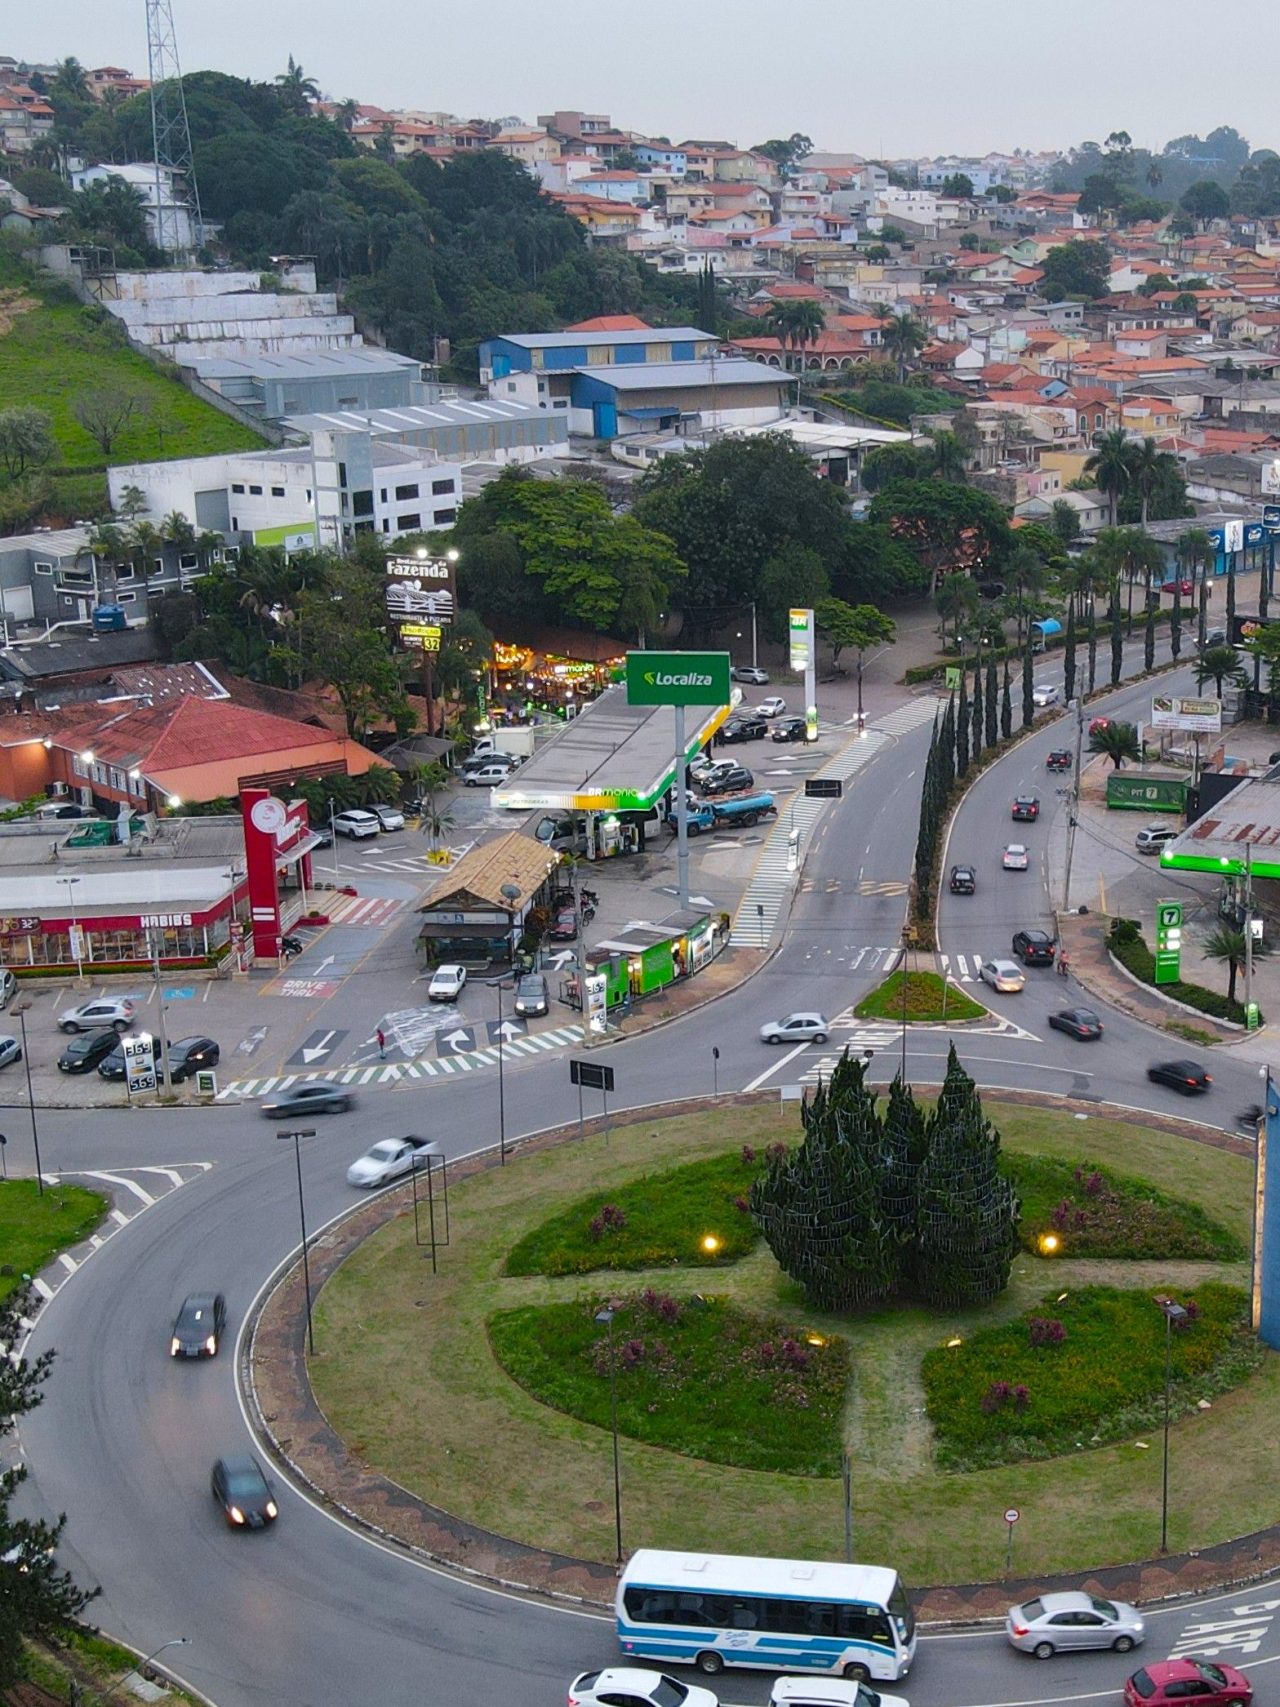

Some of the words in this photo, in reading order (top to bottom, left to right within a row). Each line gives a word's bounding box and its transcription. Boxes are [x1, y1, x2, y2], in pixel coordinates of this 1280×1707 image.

[386, 561, 449, 578] Fazenda
[656, 673, 713, 686] Localiza
[1131, 788, 1144, 796] PIT
[140, 914, 192, 928] HABIB'S
[1166, 912, 1176, 923] 7
[283, 980, 328, 990] DRIVE
[280, 988, 317, 997] THRU
